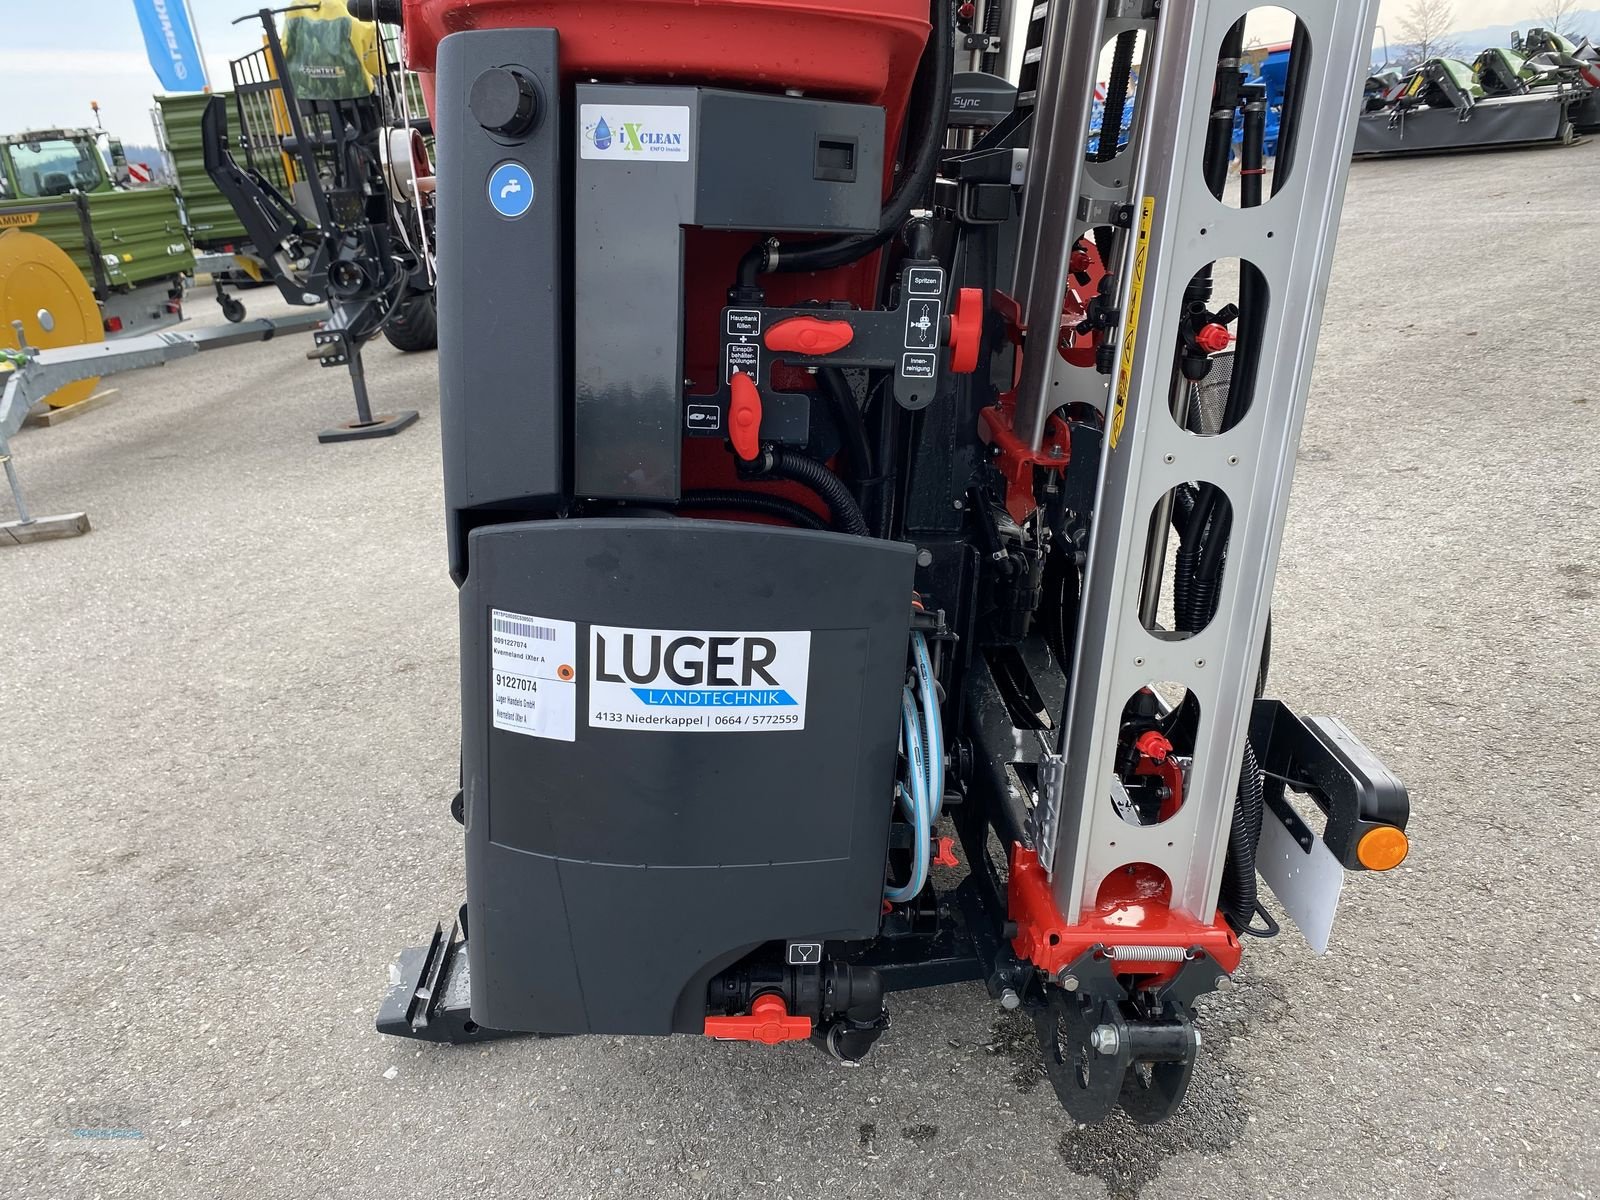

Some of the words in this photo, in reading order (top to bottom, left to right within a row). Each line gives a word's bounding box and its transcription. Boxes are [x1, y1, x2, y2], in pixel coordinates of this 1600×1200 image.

[953, 96, 981, 109] Sync
[914, 277, 937, 285] Spritzen
[730, 314, 758, 322] Haupttank
[732, 345, 754, 353] Einspül-
[906, 365, 931, 373] reinigung
[493, 636, 528, 649] 0091227074
[493, 647, 524, 660] Kverneland
[596, 631, 780, 687] LUGER
[496, 673, 537, 693] 91227074
[495, 693, 507, 705] Luger
[523, 698, 536, 710] GmbH
[649, 690, 780, 705] LANDTECHNIK
[595, 711, 623, 723] 4133
[625, 713, 704, 727] Niederkappel
[714, 714, 742, 726] 0664
[752, 713, 799, 725] 5772559
